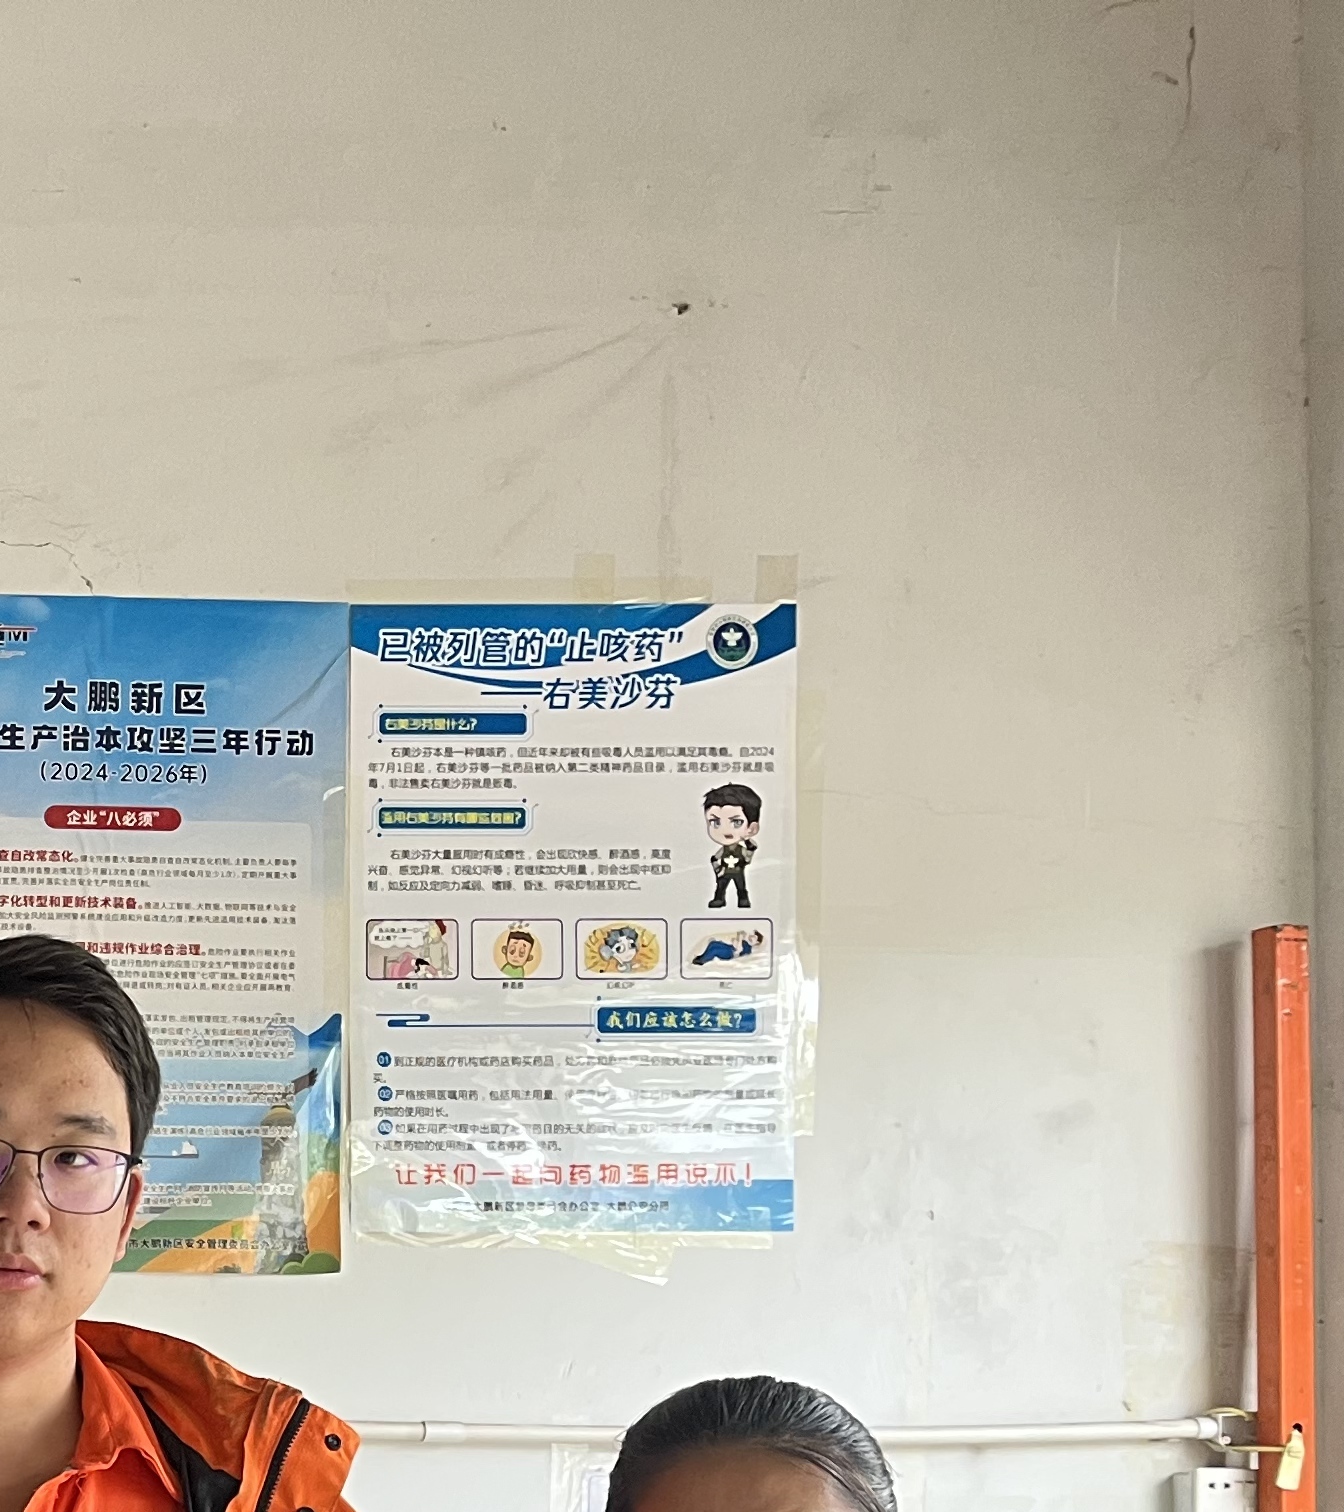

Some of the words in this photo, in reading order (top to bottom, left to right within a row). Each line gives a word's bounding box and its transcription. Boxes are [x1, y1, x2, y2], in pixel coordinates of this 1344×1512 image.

[378, 629, 684, 665] 已被列管的“止咳药”
[43, 680, 207, 716] 大鹏新区
[66, 808, 161, 828] 企业“八必须”
